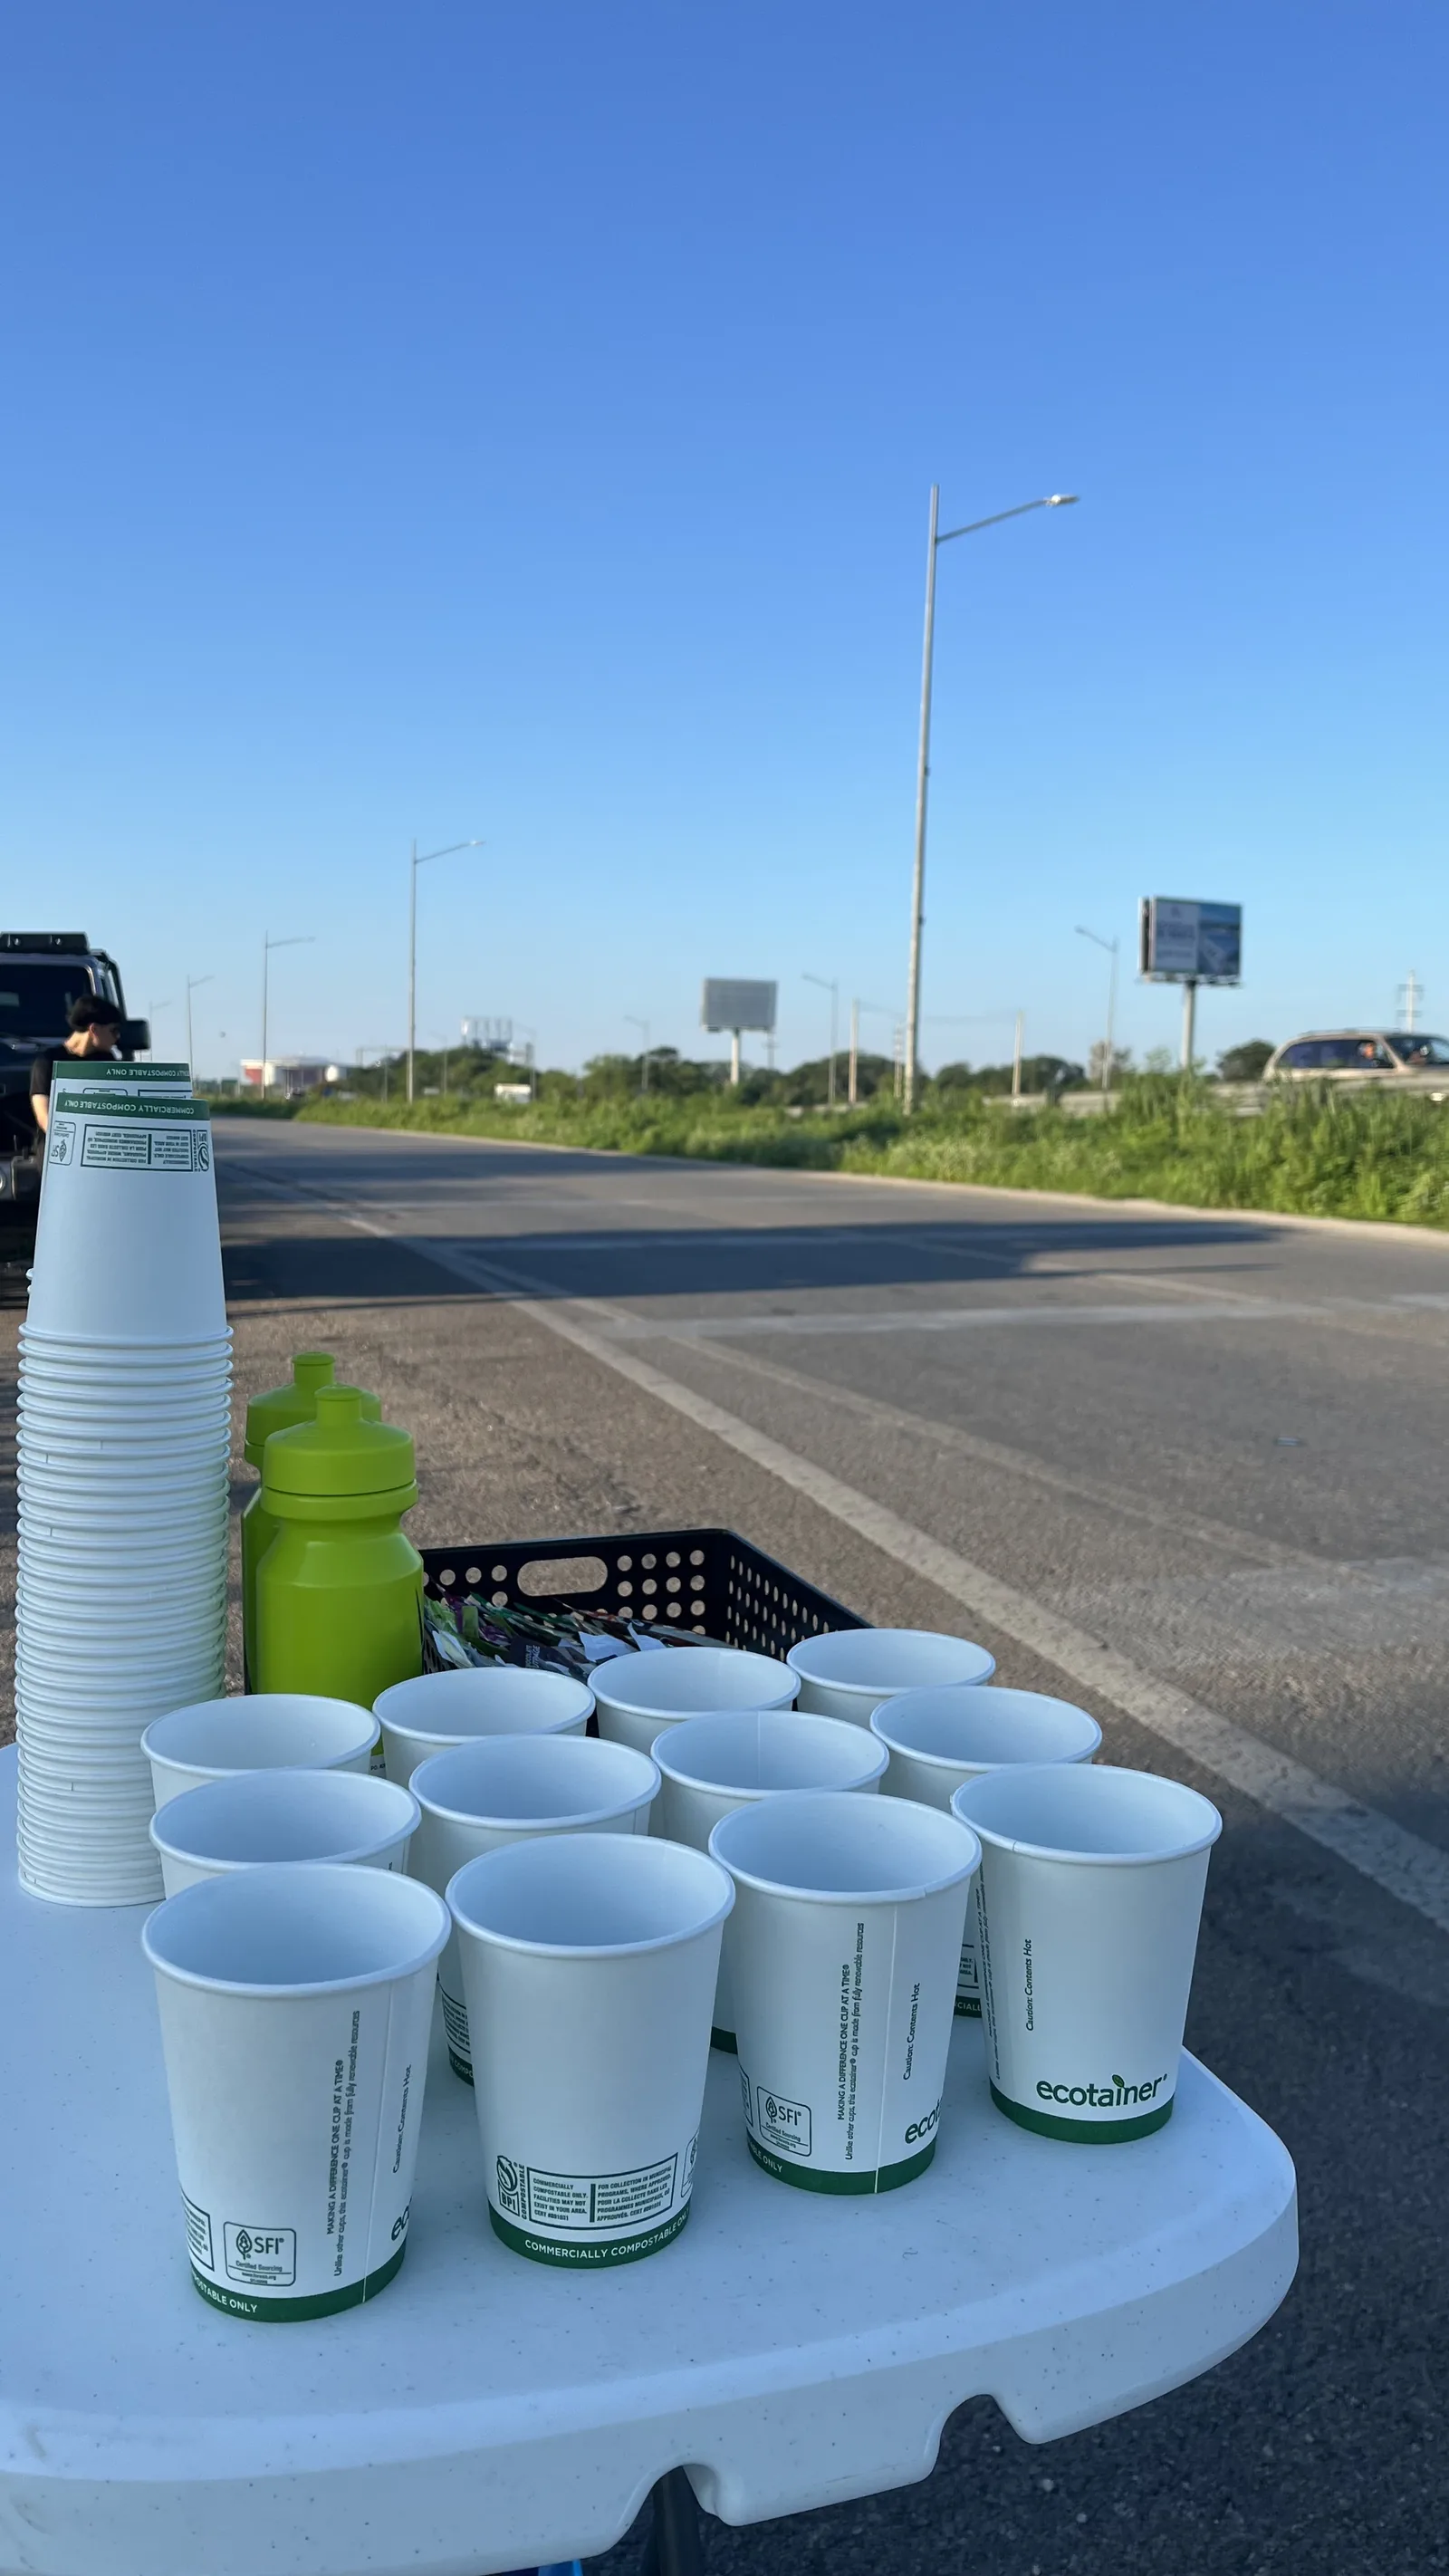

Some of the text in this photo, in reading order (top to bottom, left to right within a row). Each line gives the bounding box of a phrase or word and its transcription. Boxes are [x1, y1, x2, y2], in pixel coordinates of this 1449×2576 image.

[80, 1101, 136, 1110] COMPOSTABLE
[139, 1105, 194, 1114] COMMERCIALLY
[856, 1922, 864, 1953] resources
[853, 1954, 863, 1986] renewable
[1023, 1938, 1033, 2031] Caution: Contents Hot
[841, 1995, 849, 2005] AT
[852, 1987, 862, 2001] fully
[851, 2002, 860, 2016] from
[351, 2011, 360, 2043] resources
[851, 2018, 859, 2036] made
[903, 1983, 920, 2081] Caution: Contents Hot
[851, 2045, 859, 2056] cup
[348, 2045, 358, 2081] renewable
[839, 2041, 847, 2081] DIFFERENCE
[345, 2083, 357, 2097] fully
[1036, 2074, 1162, 2108] ecotainer
[333, 2094, 341, 2104] AT
[344, 2099, 354, 2115] from
[848, 2094, 856, 2105] this
[332, 2106, 341, 2123] CUP
[393, 2064, 411, 2174] Caution: Contents Hot
[331, 2125, 340, 2143] ONE
[344, 2117, 352, 2137] made
[343, 2147, 351, 2159] cup
[845, 2141, 853, 2160] Unlike
[329, 2145, 339, 2192] DIFFERENCE
[763, 2156, 782, 2173] ONLY
[533, 2178, 573, 2189] COMMERCIALLY
[598, 2189, 629, 2197] PROGRAMS,
[630, 2184, 648, 2192] WHERE
[610, 2177, 641, 2188] COLLECTION
[519, 2163, 527, 2220] COMPOSTABLE
[533, 2187, 571, 2197] COMPOSTABLE
[533, 2194, 561, 2204] FACILITIES
[621, 2192, 646, 2203] COLLECTE
[502, 2192, 515, 2210] BPI
[598, 2203, 633, 2213] PROGRAMMES
[327, 2202, 335, 2235] MAKING
[339, 2215, 347, 2233] cups,
[336, 2235, 344, 2252] other
[525, 2239, 608, 2259] COMMERCIALLY
[611, 2225, 677, 2256] COMPOSTABLE
[235, 2260, 256, 2270] Certified
[333, 2254, 342, 2276] Unlike
[229, 2299, 258, 2313] ONLY
